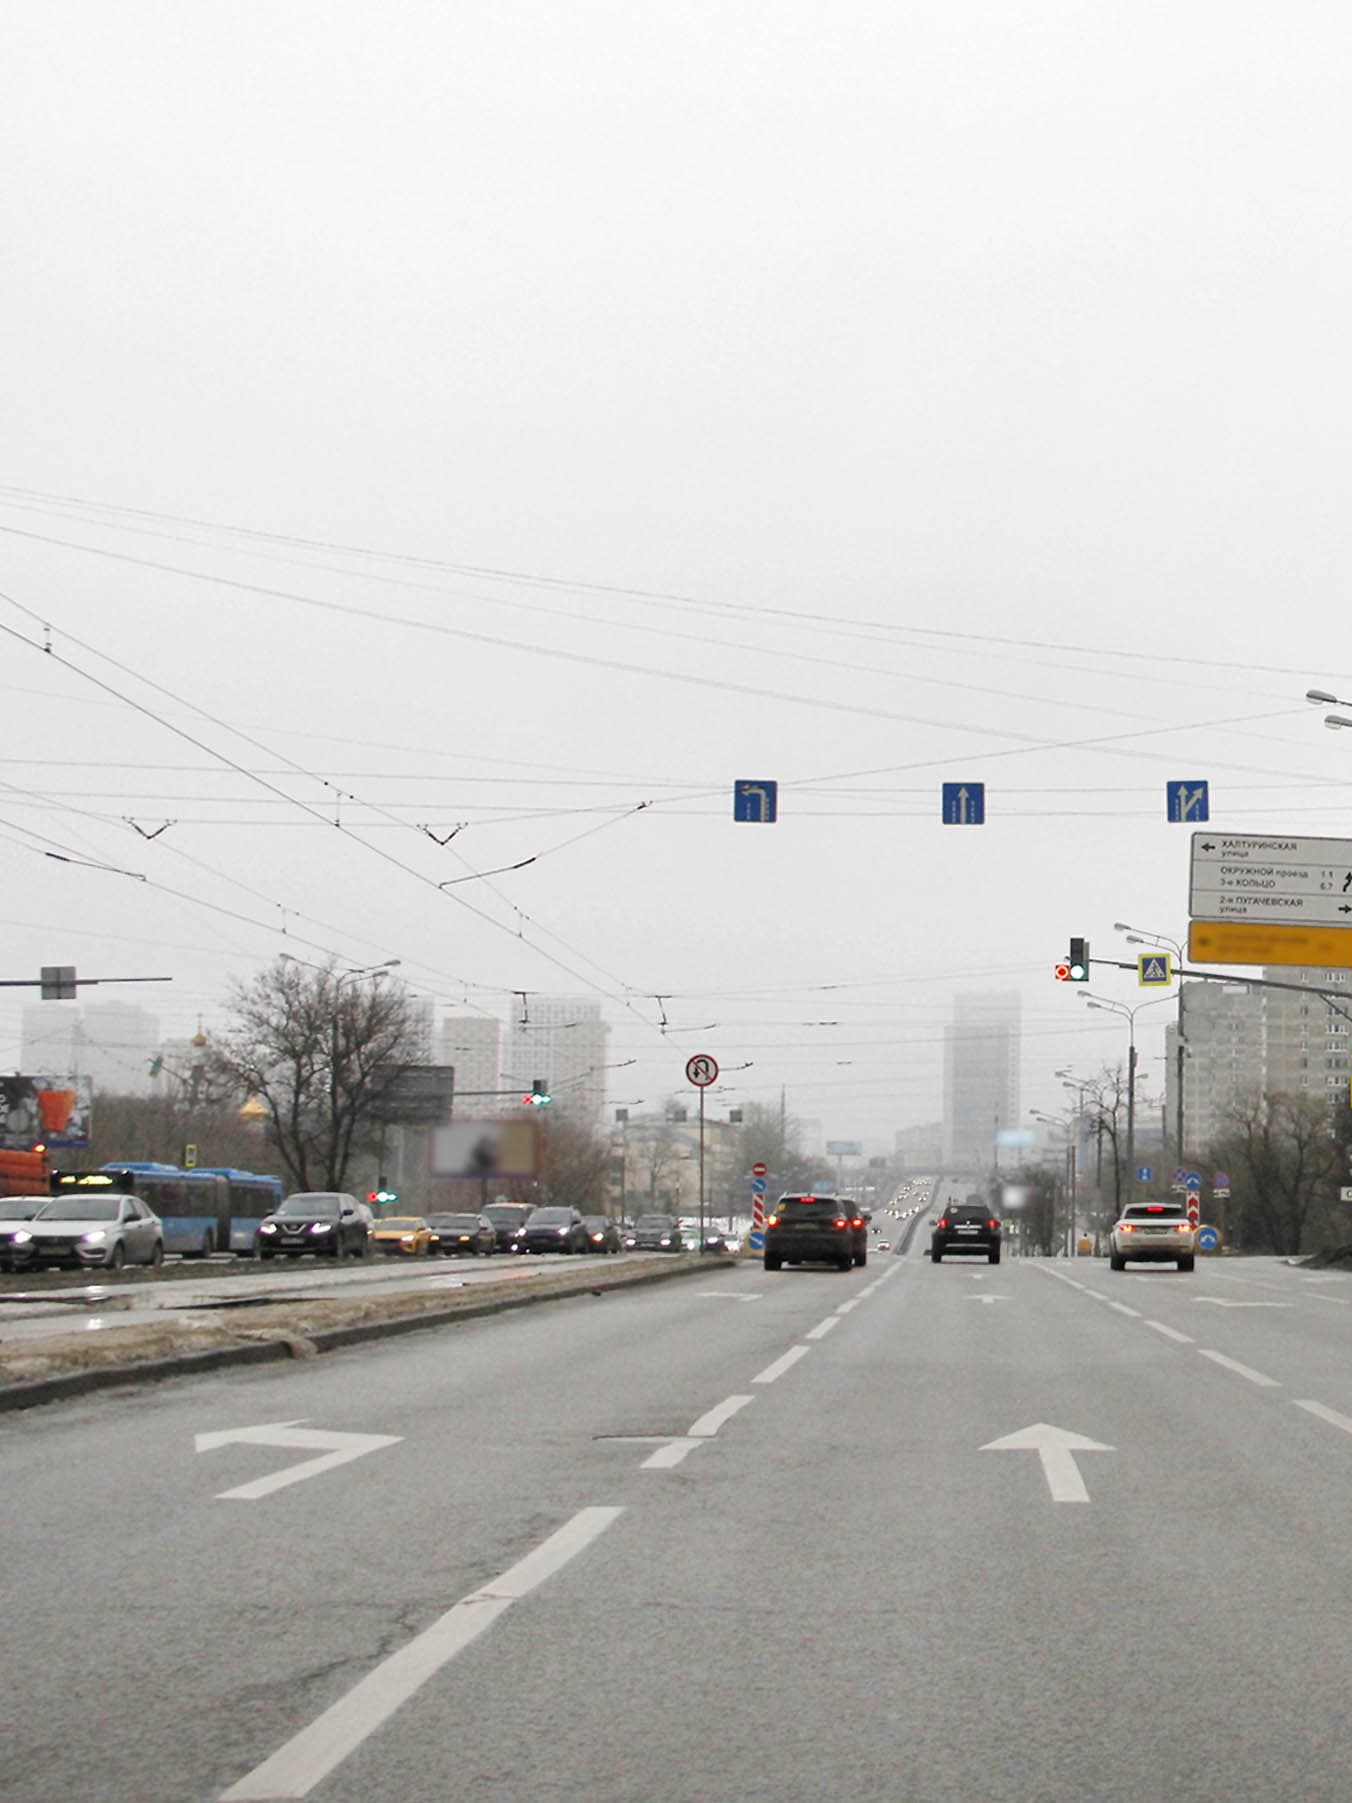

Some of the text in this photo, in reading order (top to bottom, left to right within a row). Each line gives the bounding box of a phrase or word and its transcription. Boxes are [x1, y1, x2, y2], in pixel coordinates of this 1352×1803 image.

[1221, 840, 1298, 851] ХАЛТУРИНСКАЯ
[1220, 865, 1274, 876] ОКРУЖНОЙ
[1275, 869, 1309, 879] проезд
[1235, 878, 1276, 888] КОЛЬЦО
[1235, 896, 1304, 907] ПУГАЧЕВСКАЯ
[1219, 906, 1248, 914] улица
